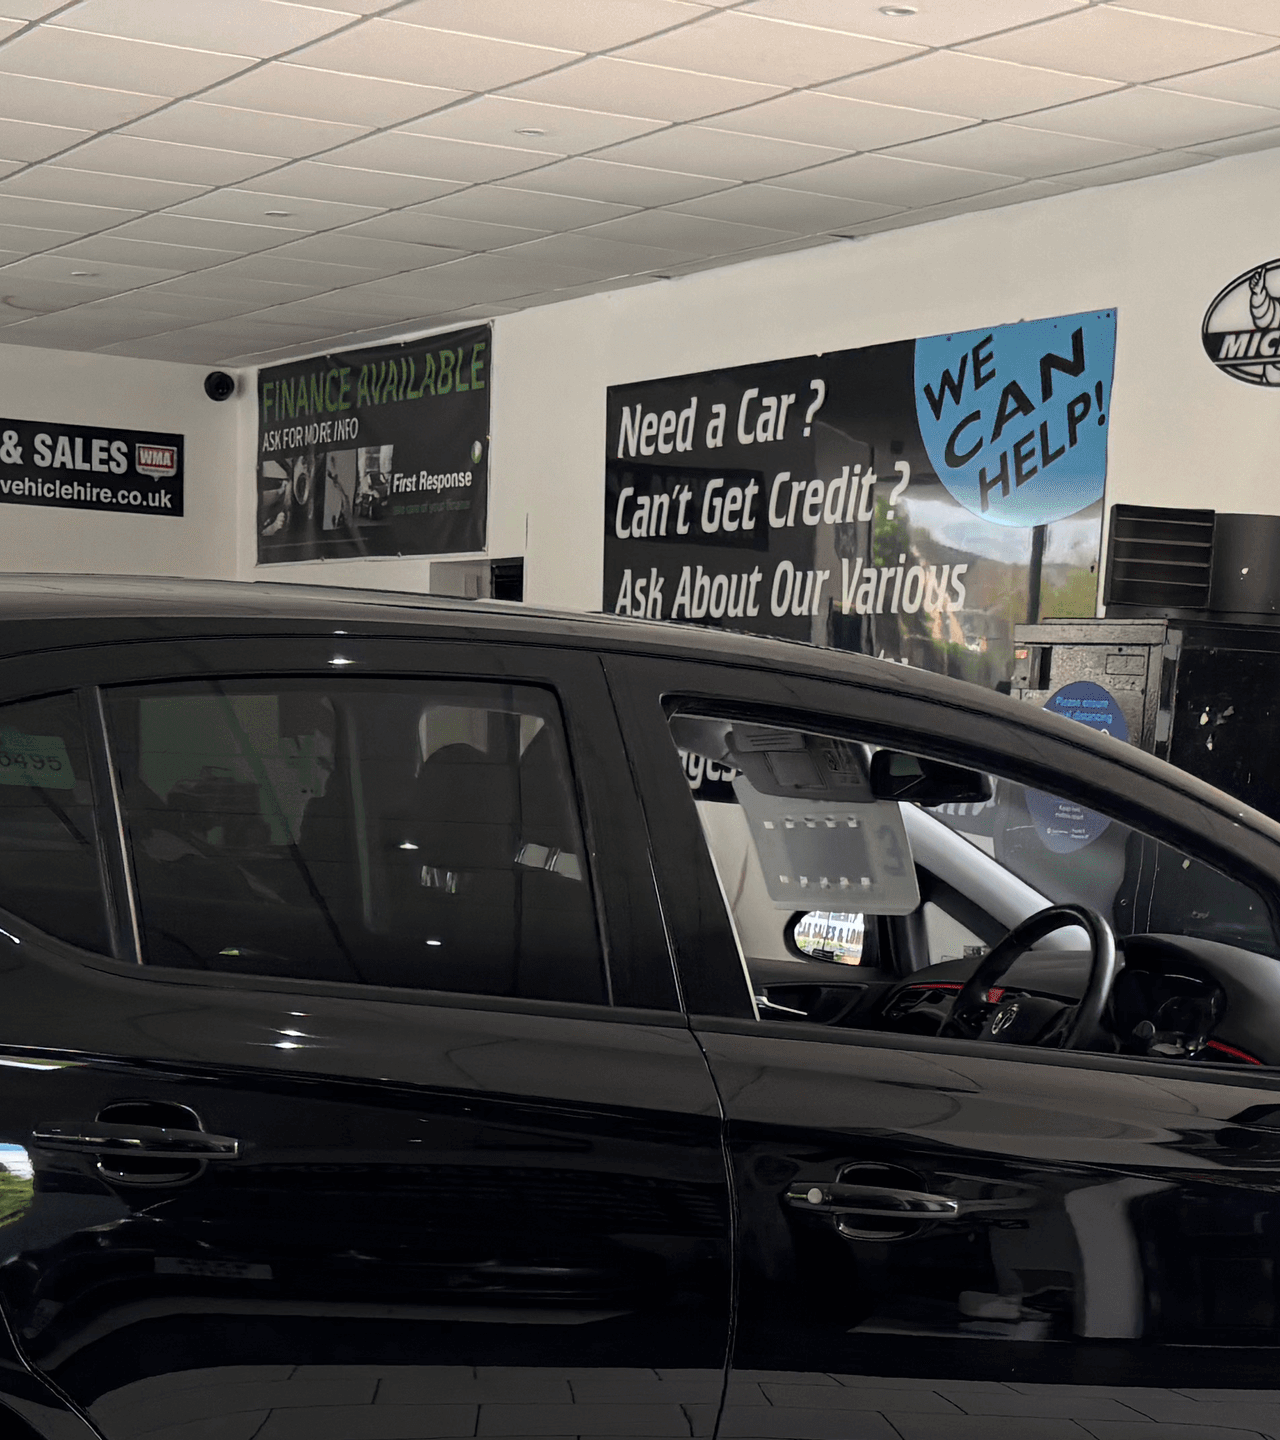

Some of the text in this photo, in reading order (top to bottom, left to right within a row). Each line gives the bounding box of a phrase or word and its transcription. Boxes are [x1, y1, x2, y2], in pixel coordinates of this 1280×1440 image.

[263, 343, 486, 424] FINANCE AVAILABLE
[923, 333, 996, 421] WE
[944, 326, 1085, 468] CAN
[0, 430, 24, 465] &
[33, 433, 128, 474] SALES
[262, 417, 359, 452] ASK FOR MORE INFO
[618, 379, 825, 458] Need a Car ?
[979, 380, 1106, 513] HELP!
[140, 449, 172, 467] WMA
[393, 470, 472, 494] First Response
[615, 461, 910, 539] Can't Get Credit ?
[615, 553, 967, 619] Ask About Our Various
